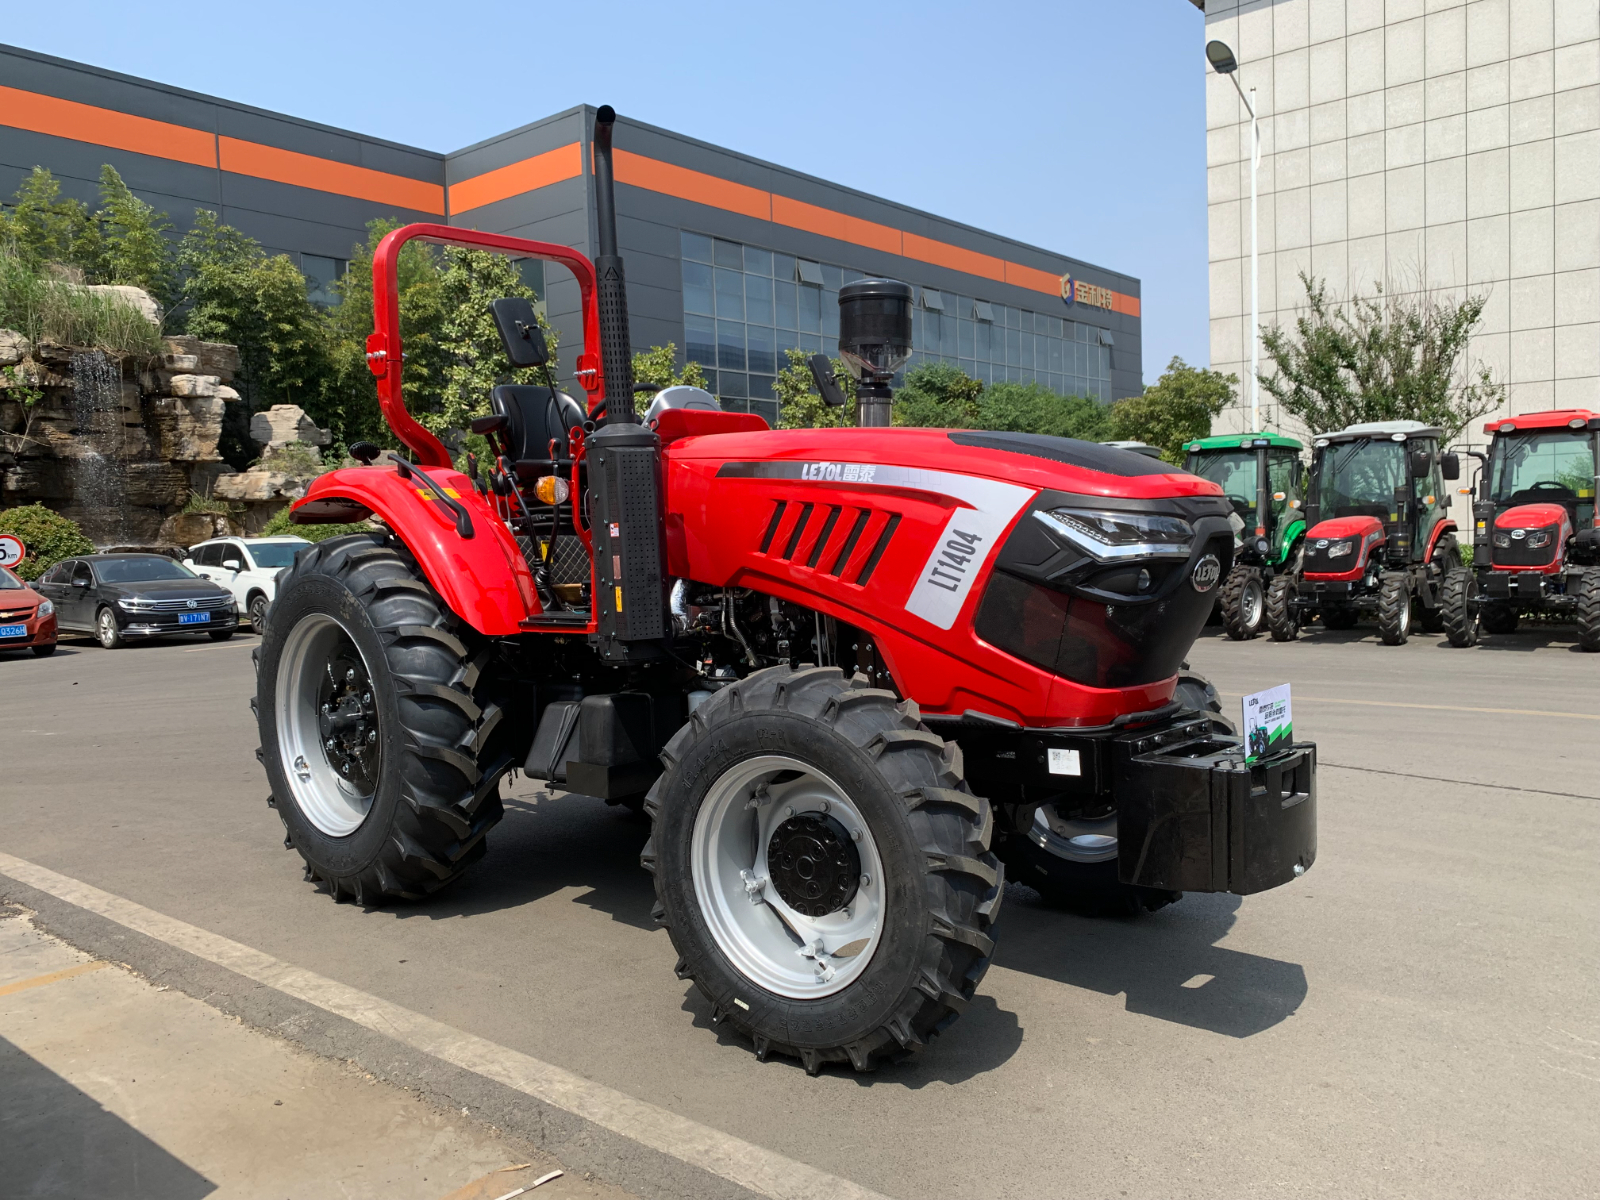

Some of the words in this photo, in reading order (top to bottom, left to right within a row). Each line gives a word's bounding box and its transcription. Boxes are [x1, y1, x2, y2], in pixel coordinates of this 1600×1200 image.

[801, 461, 842, 481] LETOL
[842, 464, 877, 483] 雷泰
[927, 529, 983, 592] LT1404
